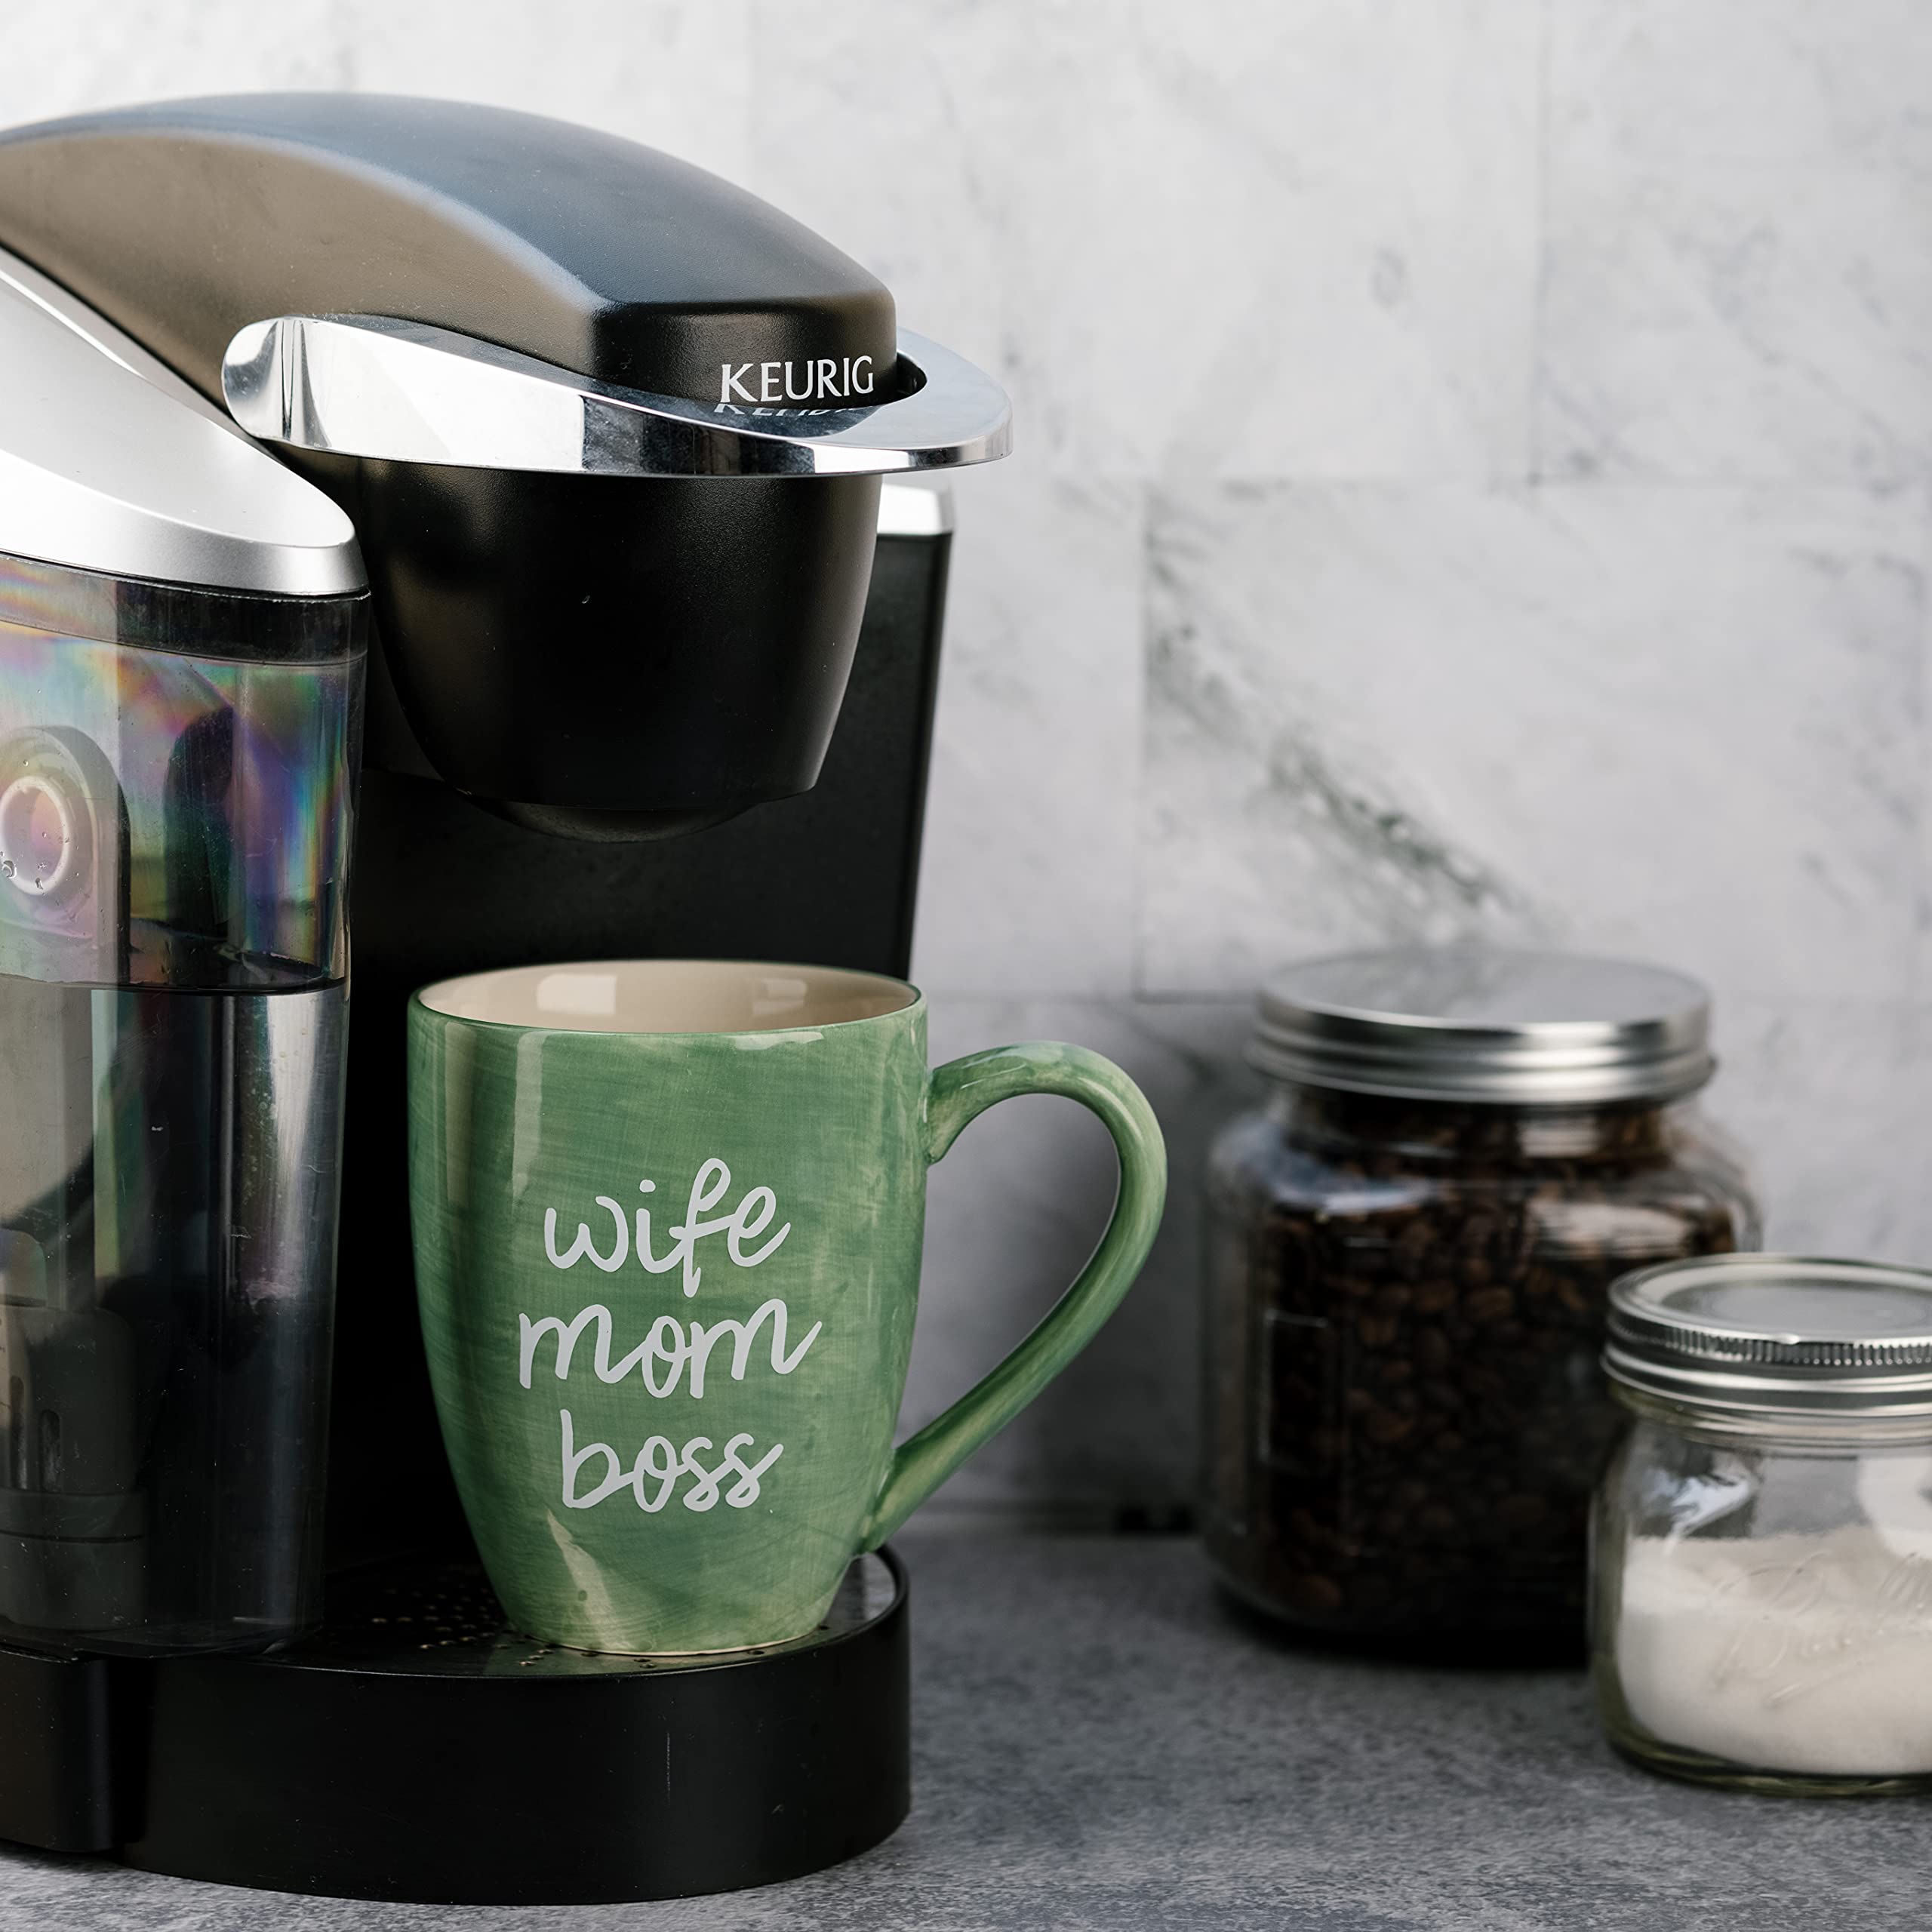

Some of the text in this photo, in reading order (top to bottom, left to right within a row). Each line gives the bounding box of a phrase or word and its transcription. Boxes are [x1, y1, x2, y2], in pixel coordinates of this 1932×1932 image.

[719, 355, 875, 403] KEURIG
[544, 1158, 791, 1298] wife
[518, 1298, 823, 1399] mom
[560, 1409, 784, 1512] boss
